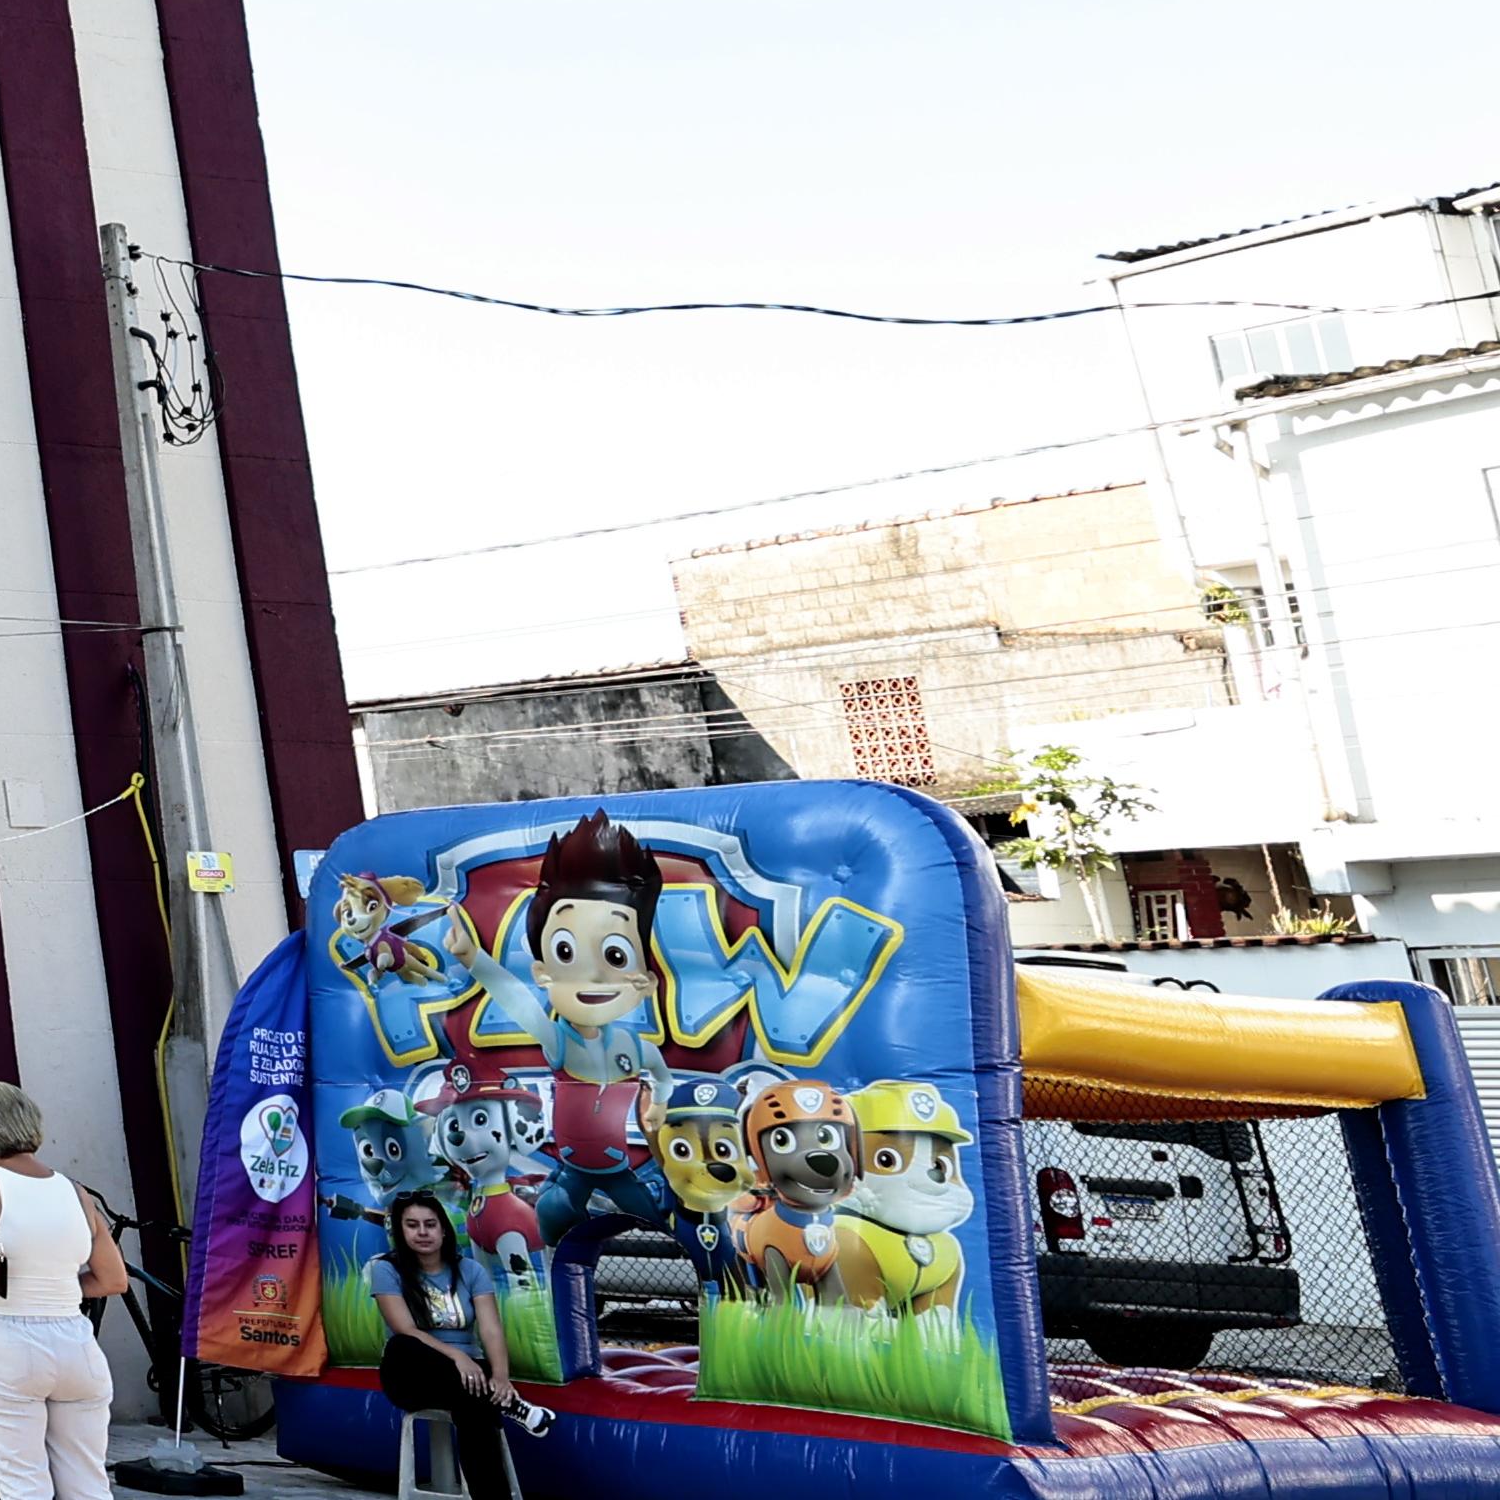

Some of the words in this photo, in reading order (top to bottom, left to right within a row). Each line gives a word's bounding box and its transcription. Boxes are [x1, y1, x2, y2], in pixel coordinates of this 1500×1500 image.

[252, 1055, 260, 1069] E
[250, 1155, 275, 1175] Zela
[240, 1325, 300, 1347] Santos
